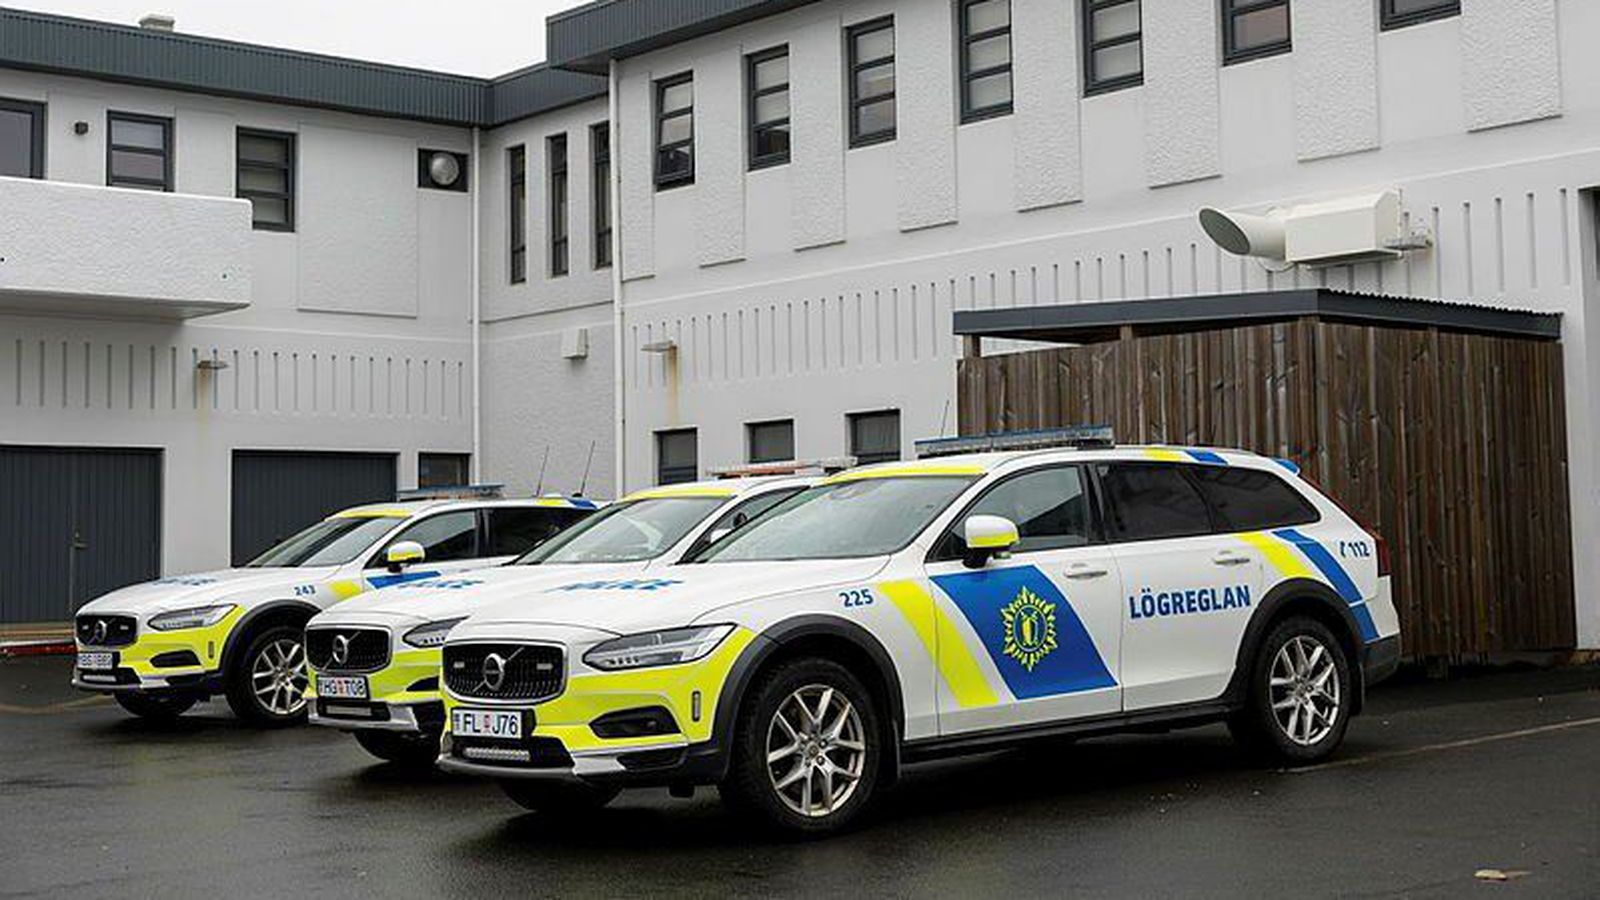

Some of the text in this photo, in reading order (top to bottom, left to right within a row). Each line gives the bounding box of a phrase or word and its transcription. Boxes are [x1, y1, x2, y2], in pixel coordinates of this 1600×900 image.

[1348, 541, 1370, 557] 112
[839, 588, 874, 607] 225
[1129, 585, 1251, 619] LÖGREGLAN
[463, 713, 518, 735] FL J76
